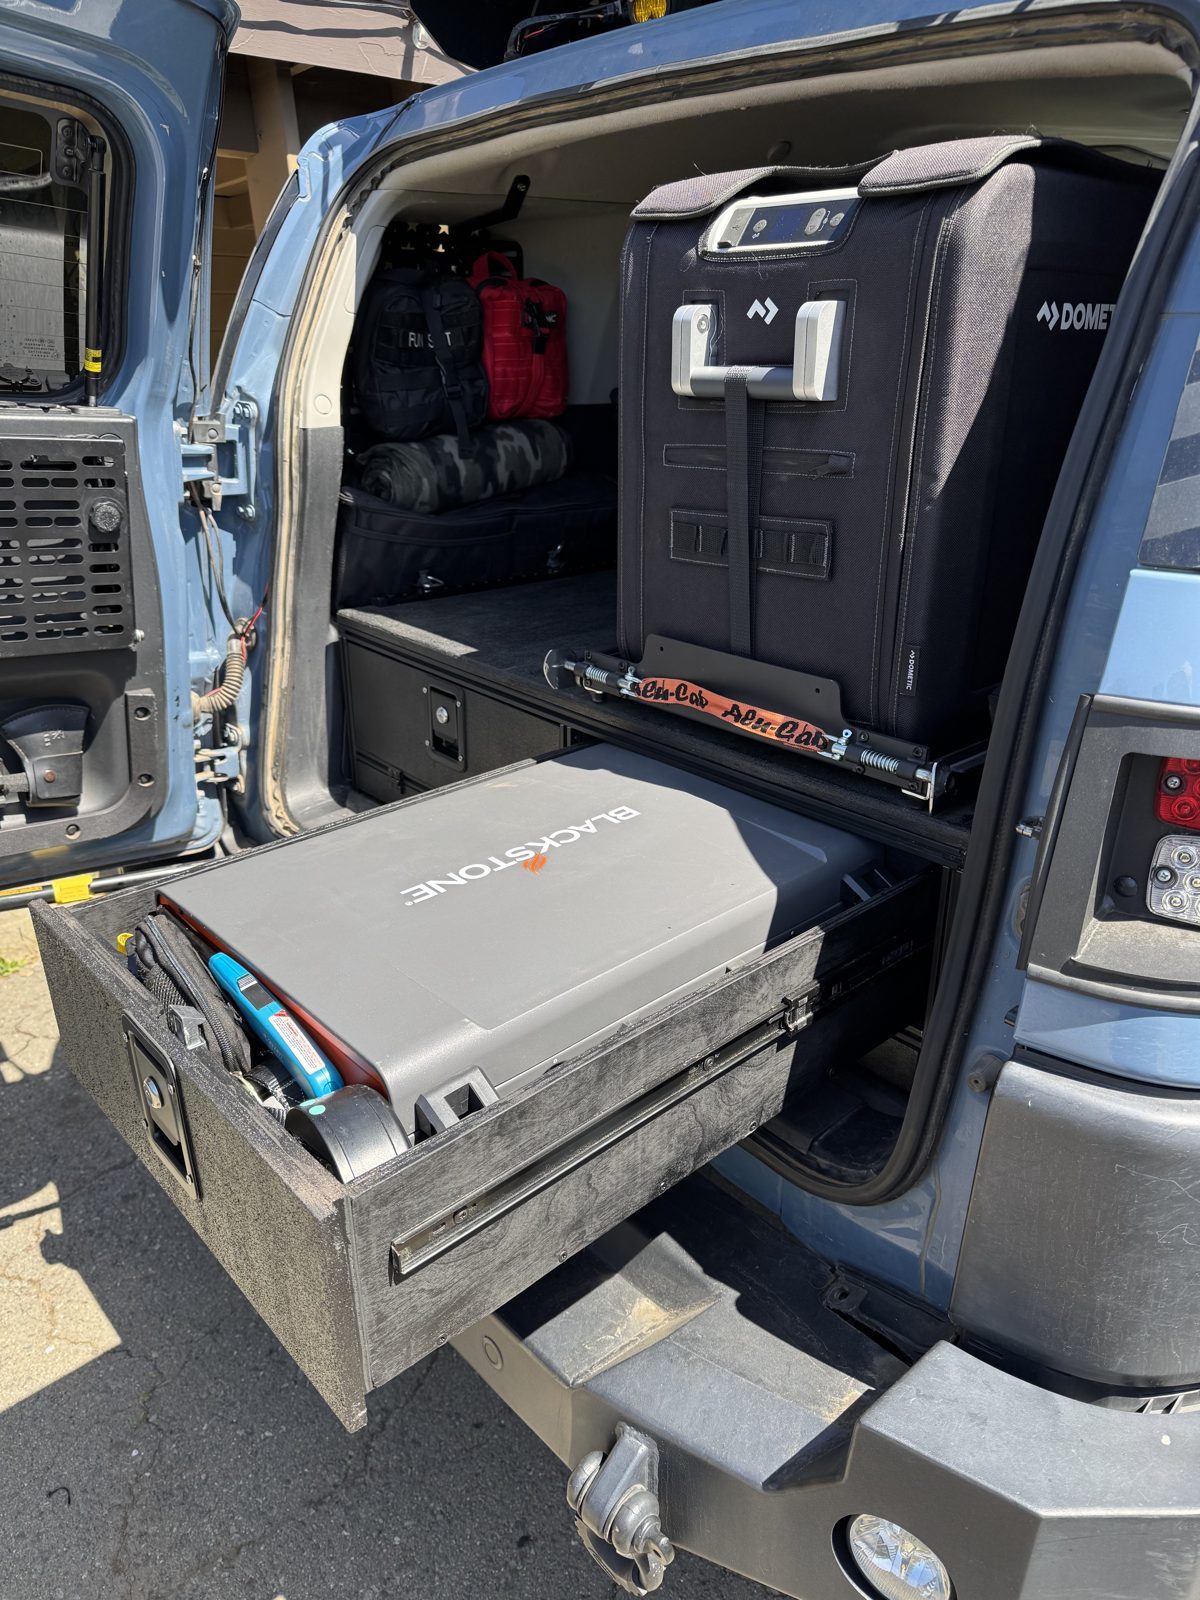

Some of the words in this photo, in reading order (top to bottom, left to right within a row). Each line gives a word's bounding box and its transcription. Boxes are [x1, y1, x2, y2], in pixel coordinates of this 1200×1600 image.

[427, 331, 452, 349] ST
[906, 659, 915, 690] DOMETIC
[400, 806, 641, 904] BLACKSTONE
